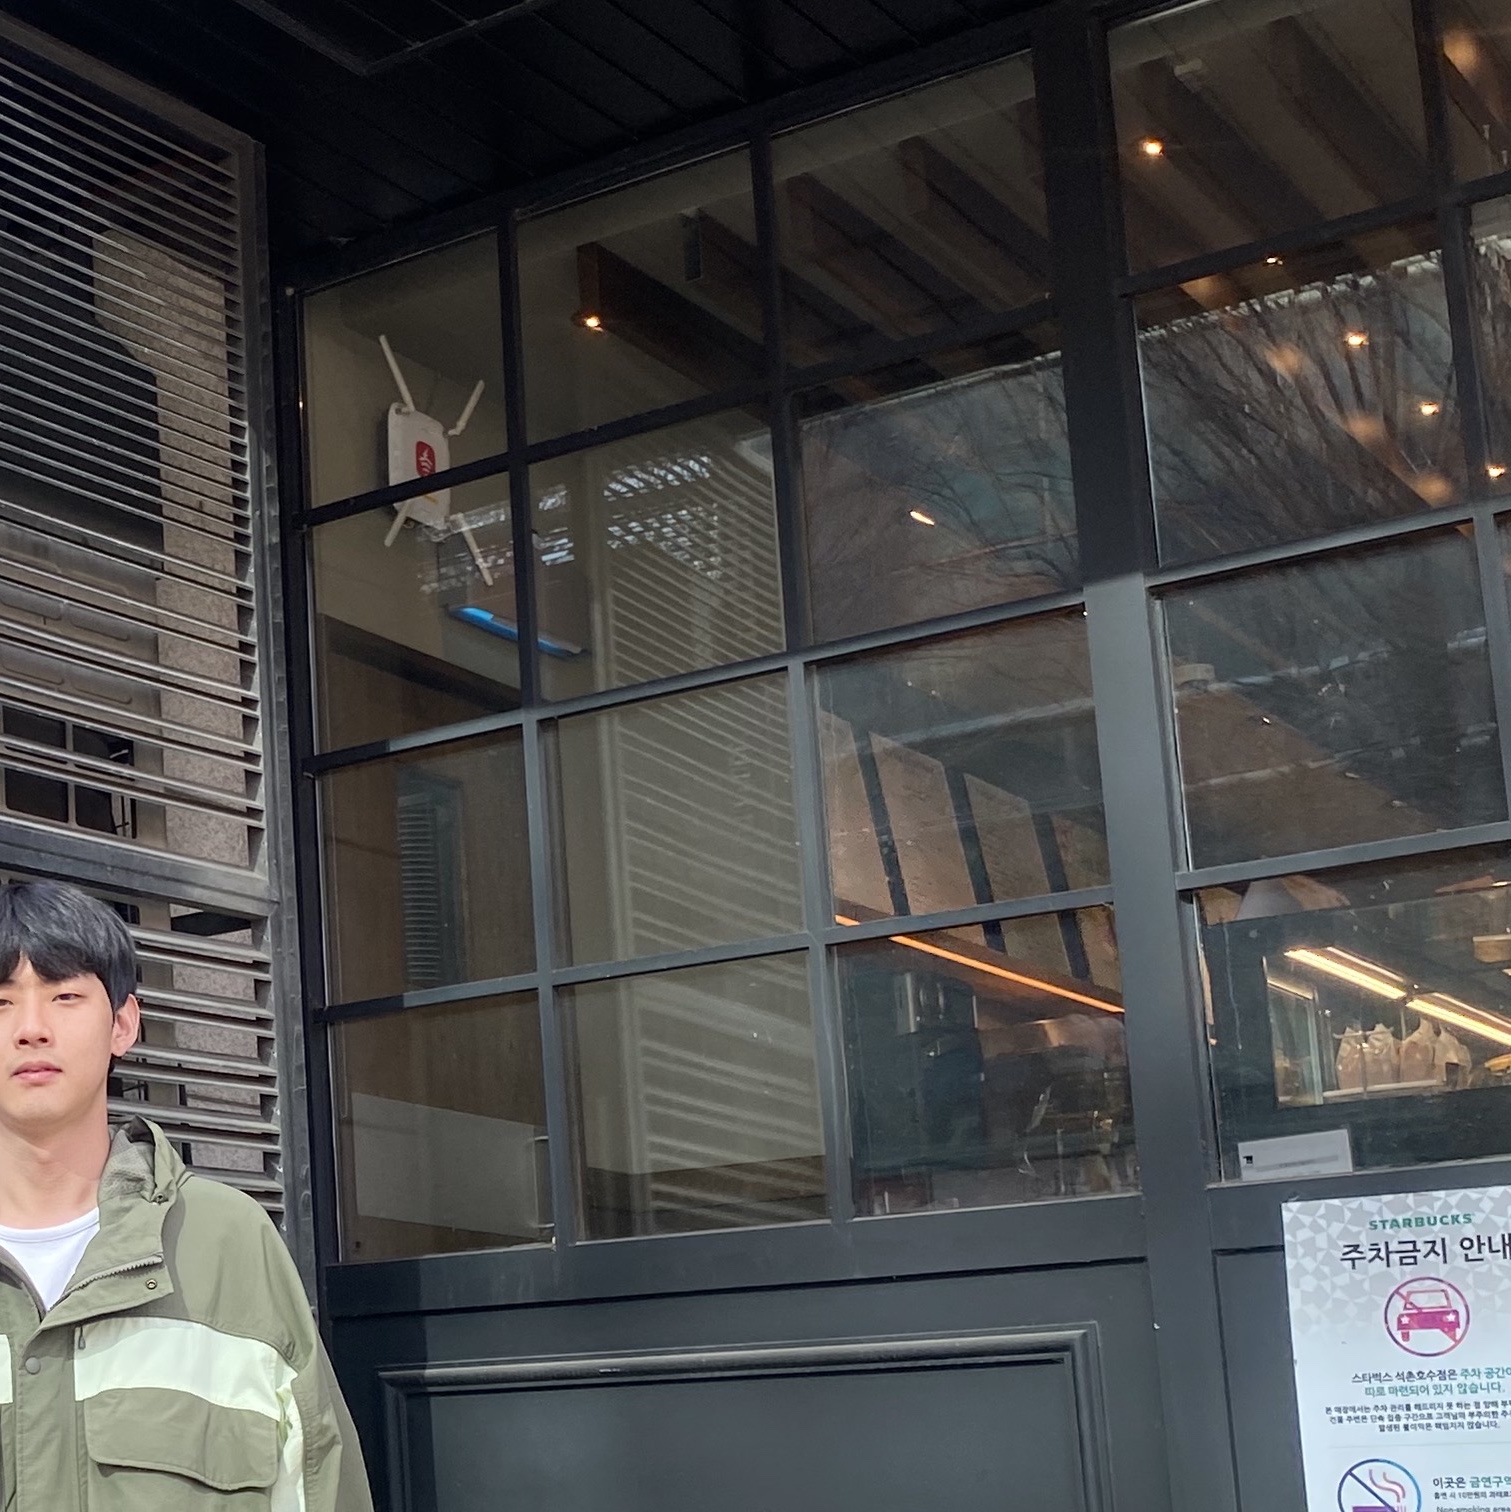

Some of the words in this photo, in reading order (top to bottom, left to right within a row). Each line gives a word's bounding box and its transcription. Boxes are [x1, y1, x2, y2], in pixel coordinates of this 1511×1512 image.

[1368, 1213, 1473, 1231] STARBUCKS
[1340, 1237, 1448, 1270] 주차금지
[1459, 1232, 1511, 1263] 안내
[1352, 1371, 1393, 1384] 스타벅스
[1395, 1369, 1458, 1383] 석촌호수점은
[1460, 1367, 1481, 1380] 주차
[1364, 1386, 1386, 1398] 따로
[1388, 1384, 1430, 1397] 마련되어
[1432, 1382, 1453, 1396] 있지
[1456, 1381, 1505, 1395] 않습니다.
[1432, 1476, 1466, 1489] 이곳은
